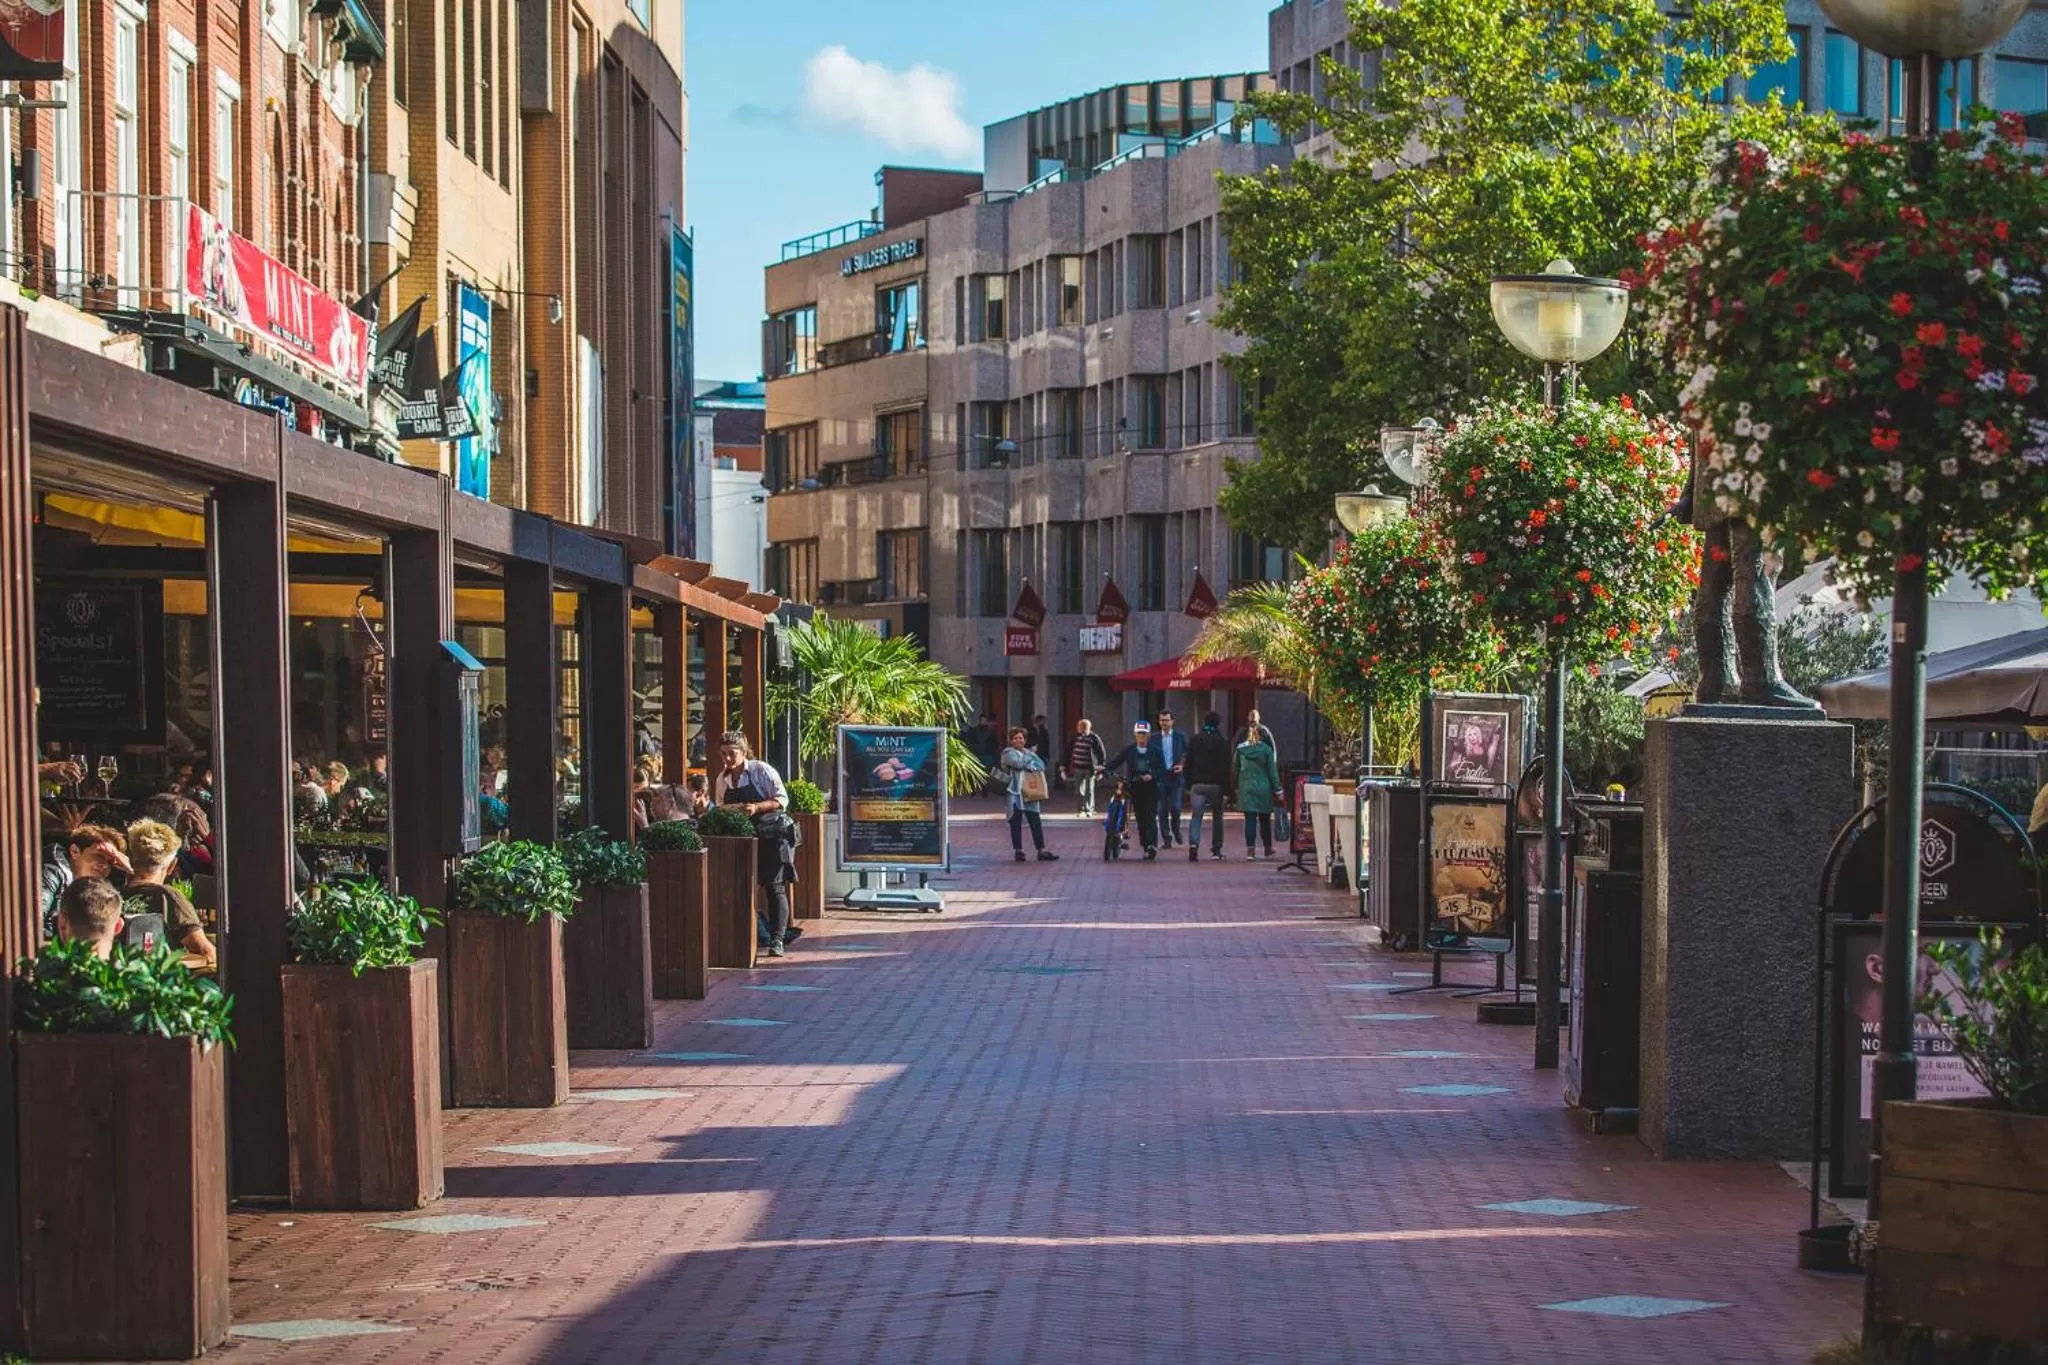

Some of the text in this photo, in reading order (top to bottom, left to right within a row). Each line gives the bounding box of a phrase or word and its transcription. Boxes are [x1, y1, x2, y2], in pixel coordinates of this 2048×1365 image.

[263, 259, 315, 342] MINT
[394, 350, 408, 365] DE
[377, 371, 405, 389] GANG
[424, 389, 438, 403] DE
[413, 418, 442, 434] GANG
[1008, 640, 1033, 649] GUYS
[875, 736, 907, 746] MINT
[1861, 1038, 1881, 1051] NO
